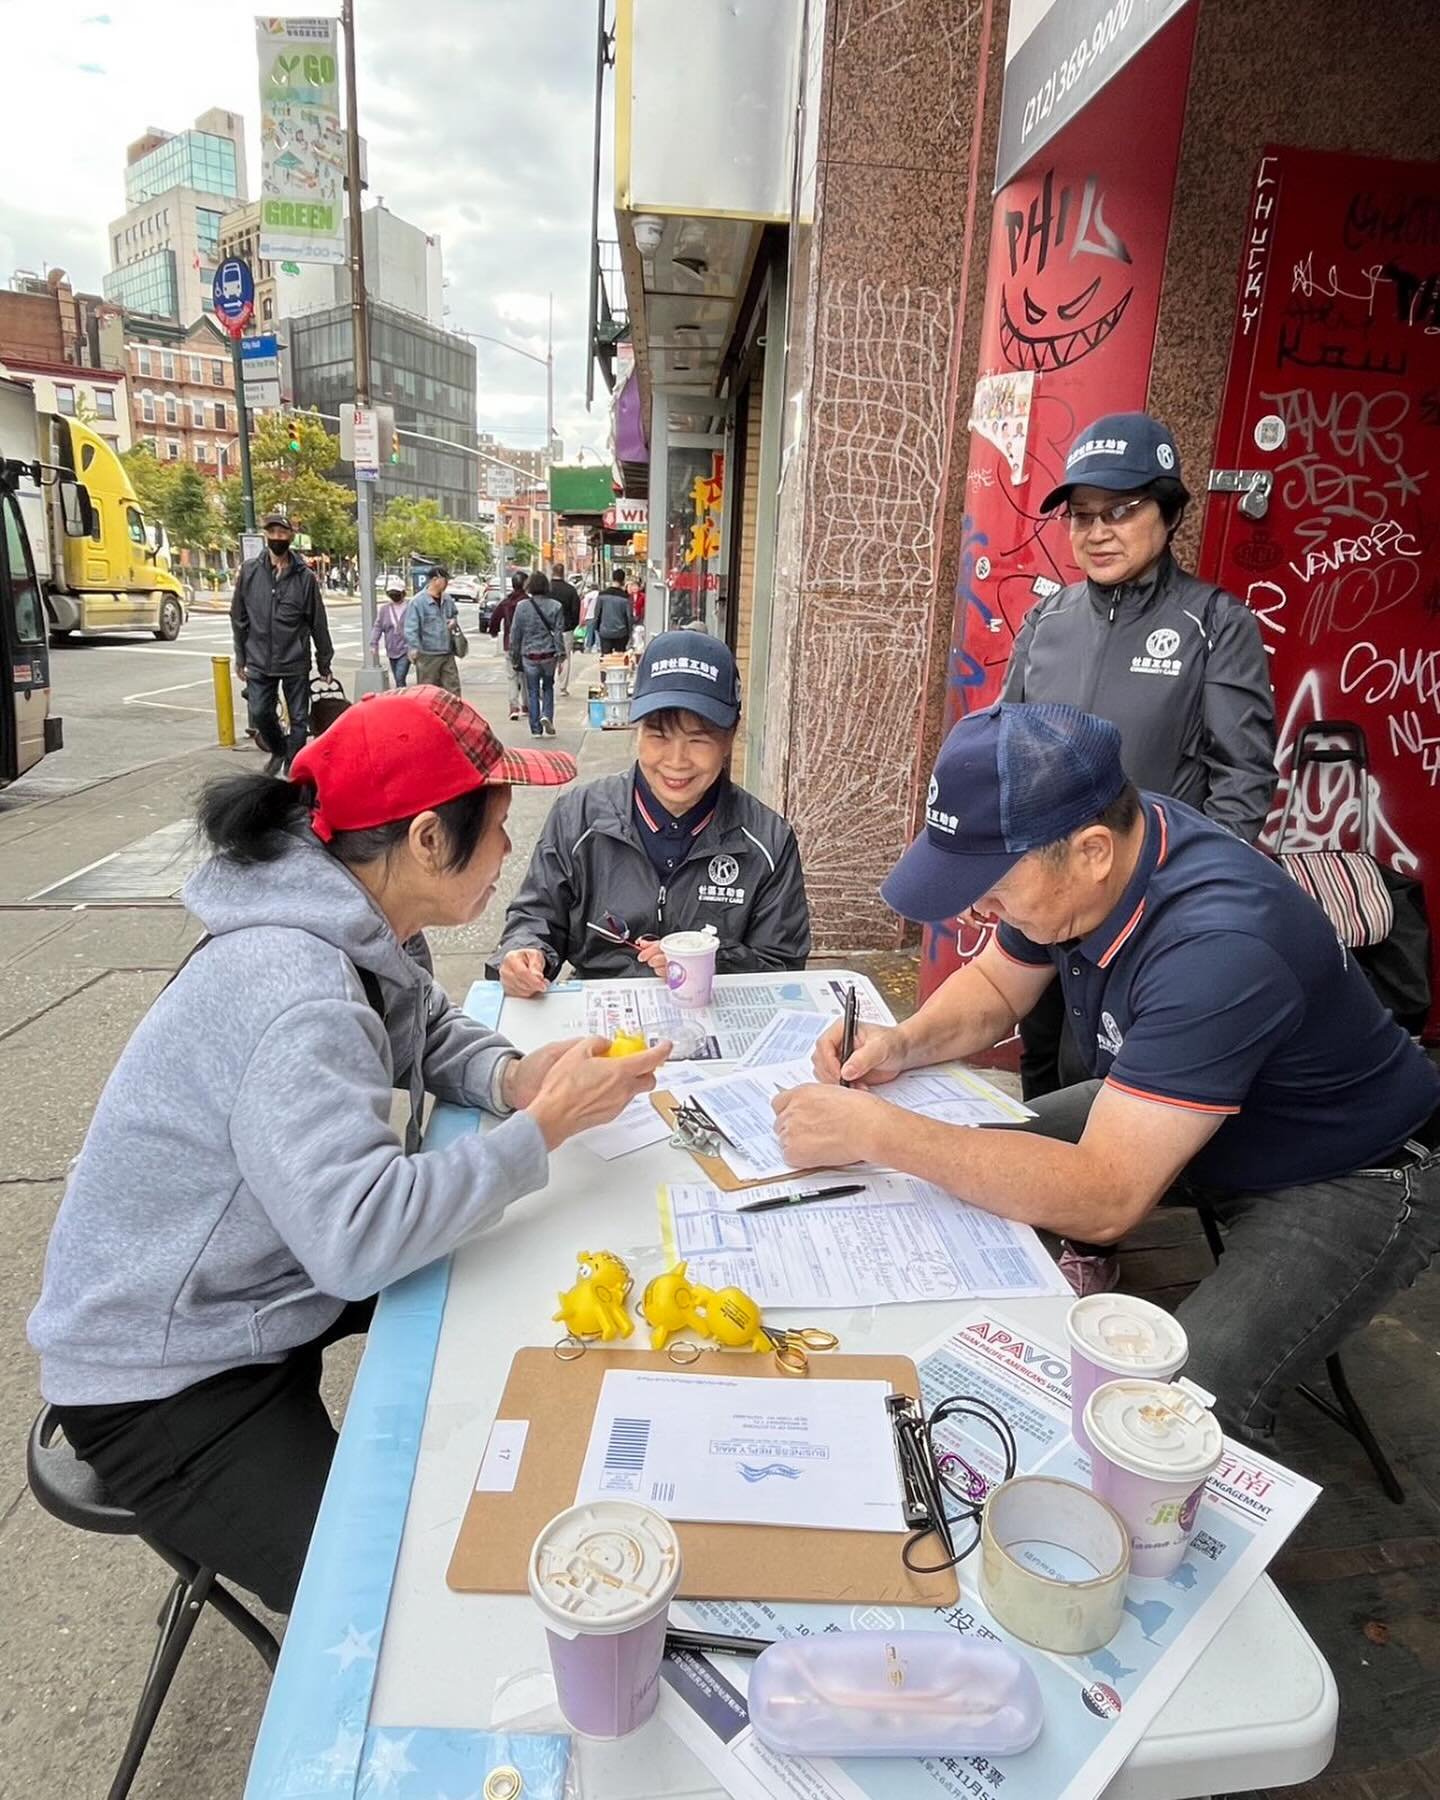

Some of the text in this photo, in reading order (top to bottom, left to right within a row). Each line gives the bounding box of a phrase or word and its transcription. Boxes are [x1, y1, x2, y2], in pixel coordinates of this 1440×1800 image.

[303, 54, 335, 86] GO
[1021, 0, 1134, 144] (212) 369-9000
[265, 201, 334, 230] GREEN
[621, 509, 649, 522] WI
[958, 1331, 1072, 1403] ASIAN PACIFIC AMERICANS VOTIN
[966, 1322, 1071, 1388] APAVO
[499, 1448, 511, 1461] 17
[714, 1445, 826, 1458] BUSINESS REPLY MAIL
[1207, 1476, 1273, 1515] ENGAGEMENT
[964, 1756, 1006, 1789] 投票
